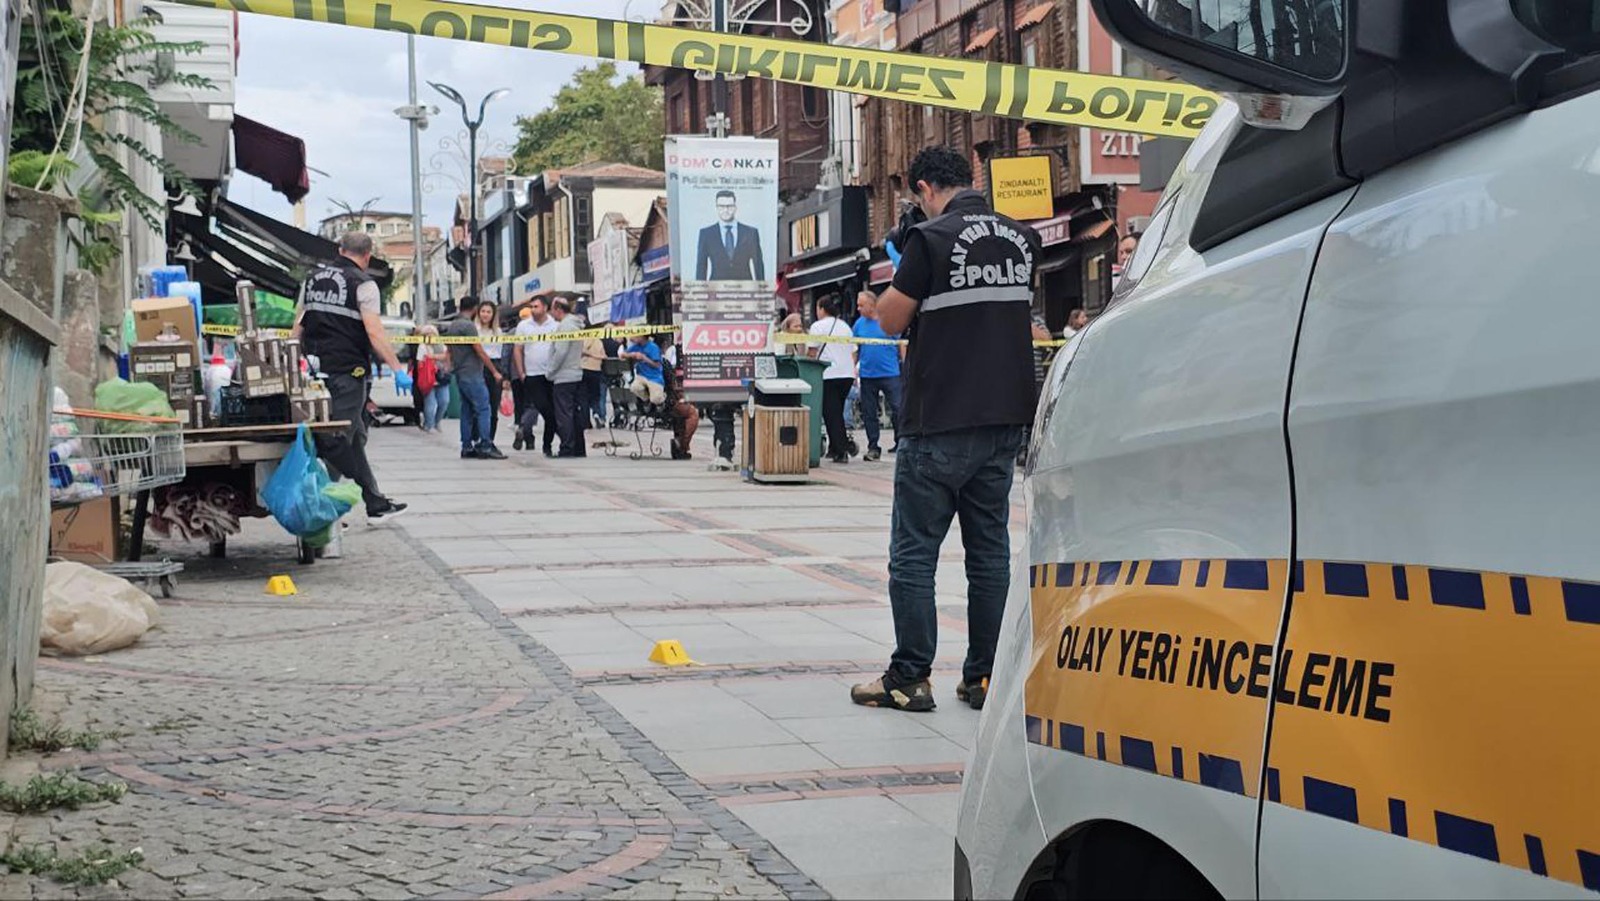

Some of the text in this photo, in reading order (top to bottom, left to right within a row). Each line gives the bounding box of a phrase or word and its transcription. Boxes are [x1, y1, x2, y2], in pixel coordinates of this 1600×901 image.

[712, 158, 773, 168] CANKAT
[997, 188, 1048, 199] RESTAURANT
[950, 242, 968, 288] OLAY
[966, 258, 1028, 286] POLİS
[1057, 624, 1114, 673] OLAY
